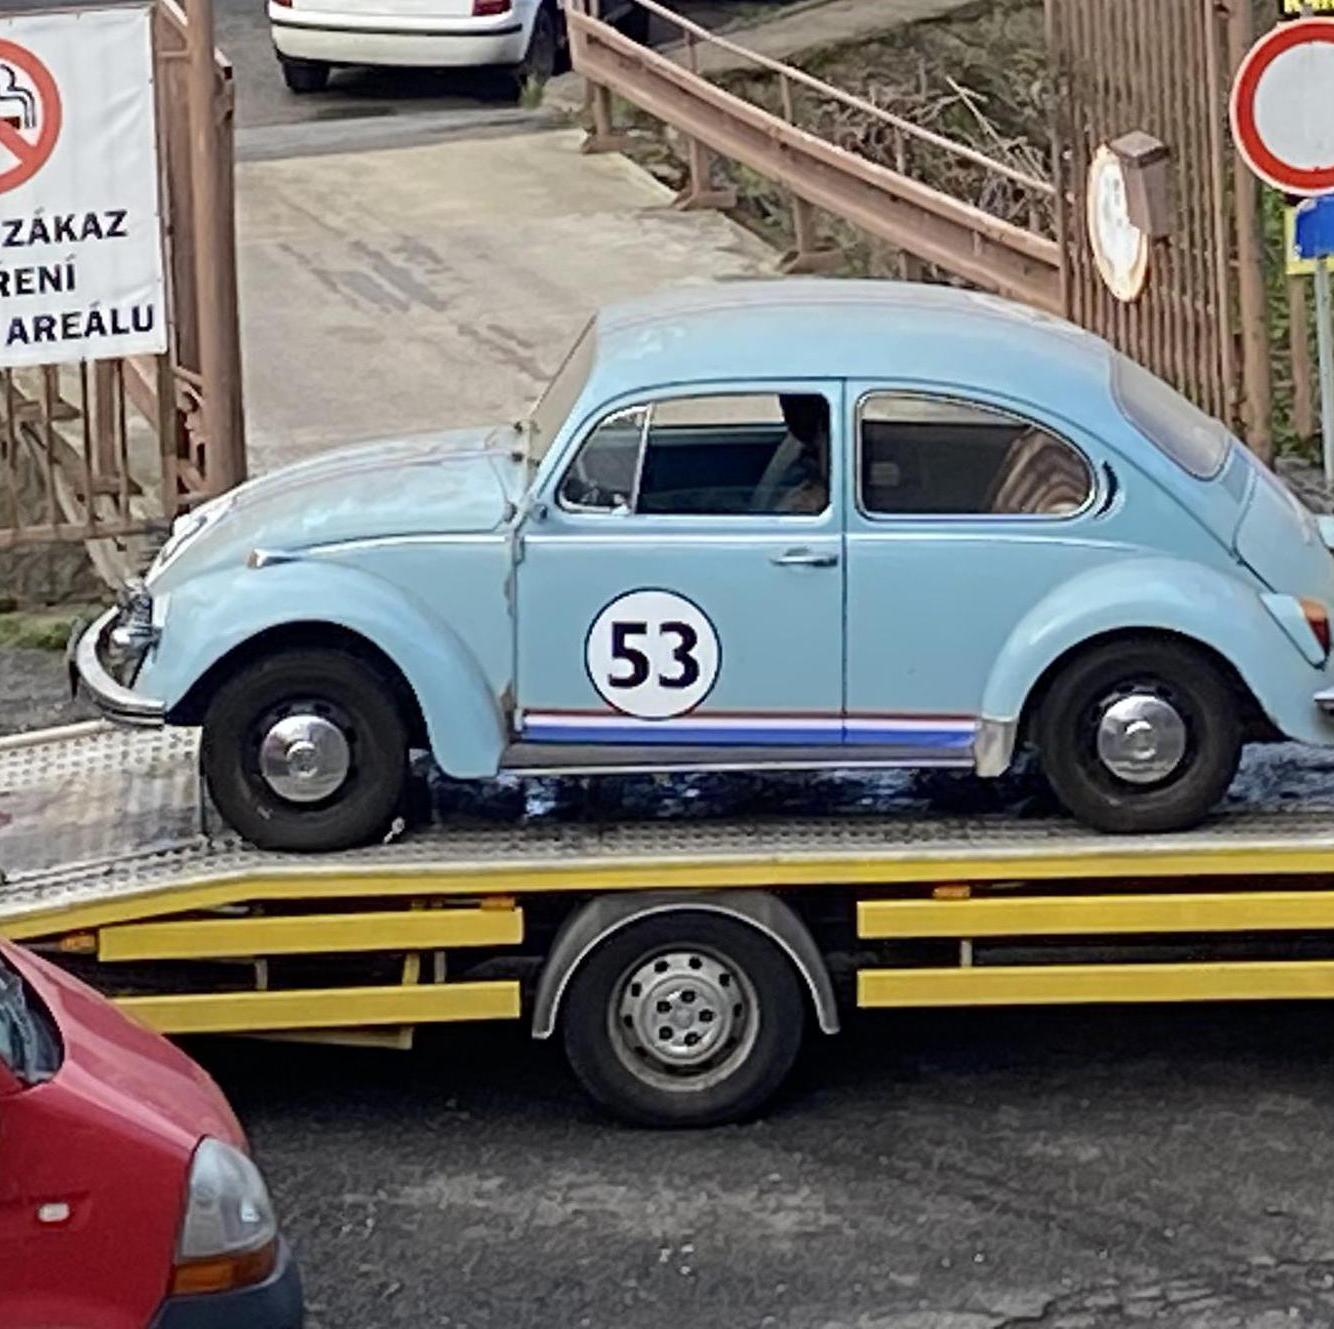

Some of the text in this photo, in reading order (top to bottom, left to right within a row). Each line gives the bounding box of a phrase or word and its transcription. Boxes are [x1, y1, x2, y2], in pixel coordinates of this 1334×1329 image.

[2, 206, 129, 249] ZÁKAZ
[6, 301, 155, 347] AREÁLU
[608, 621, 700, 690] 53
